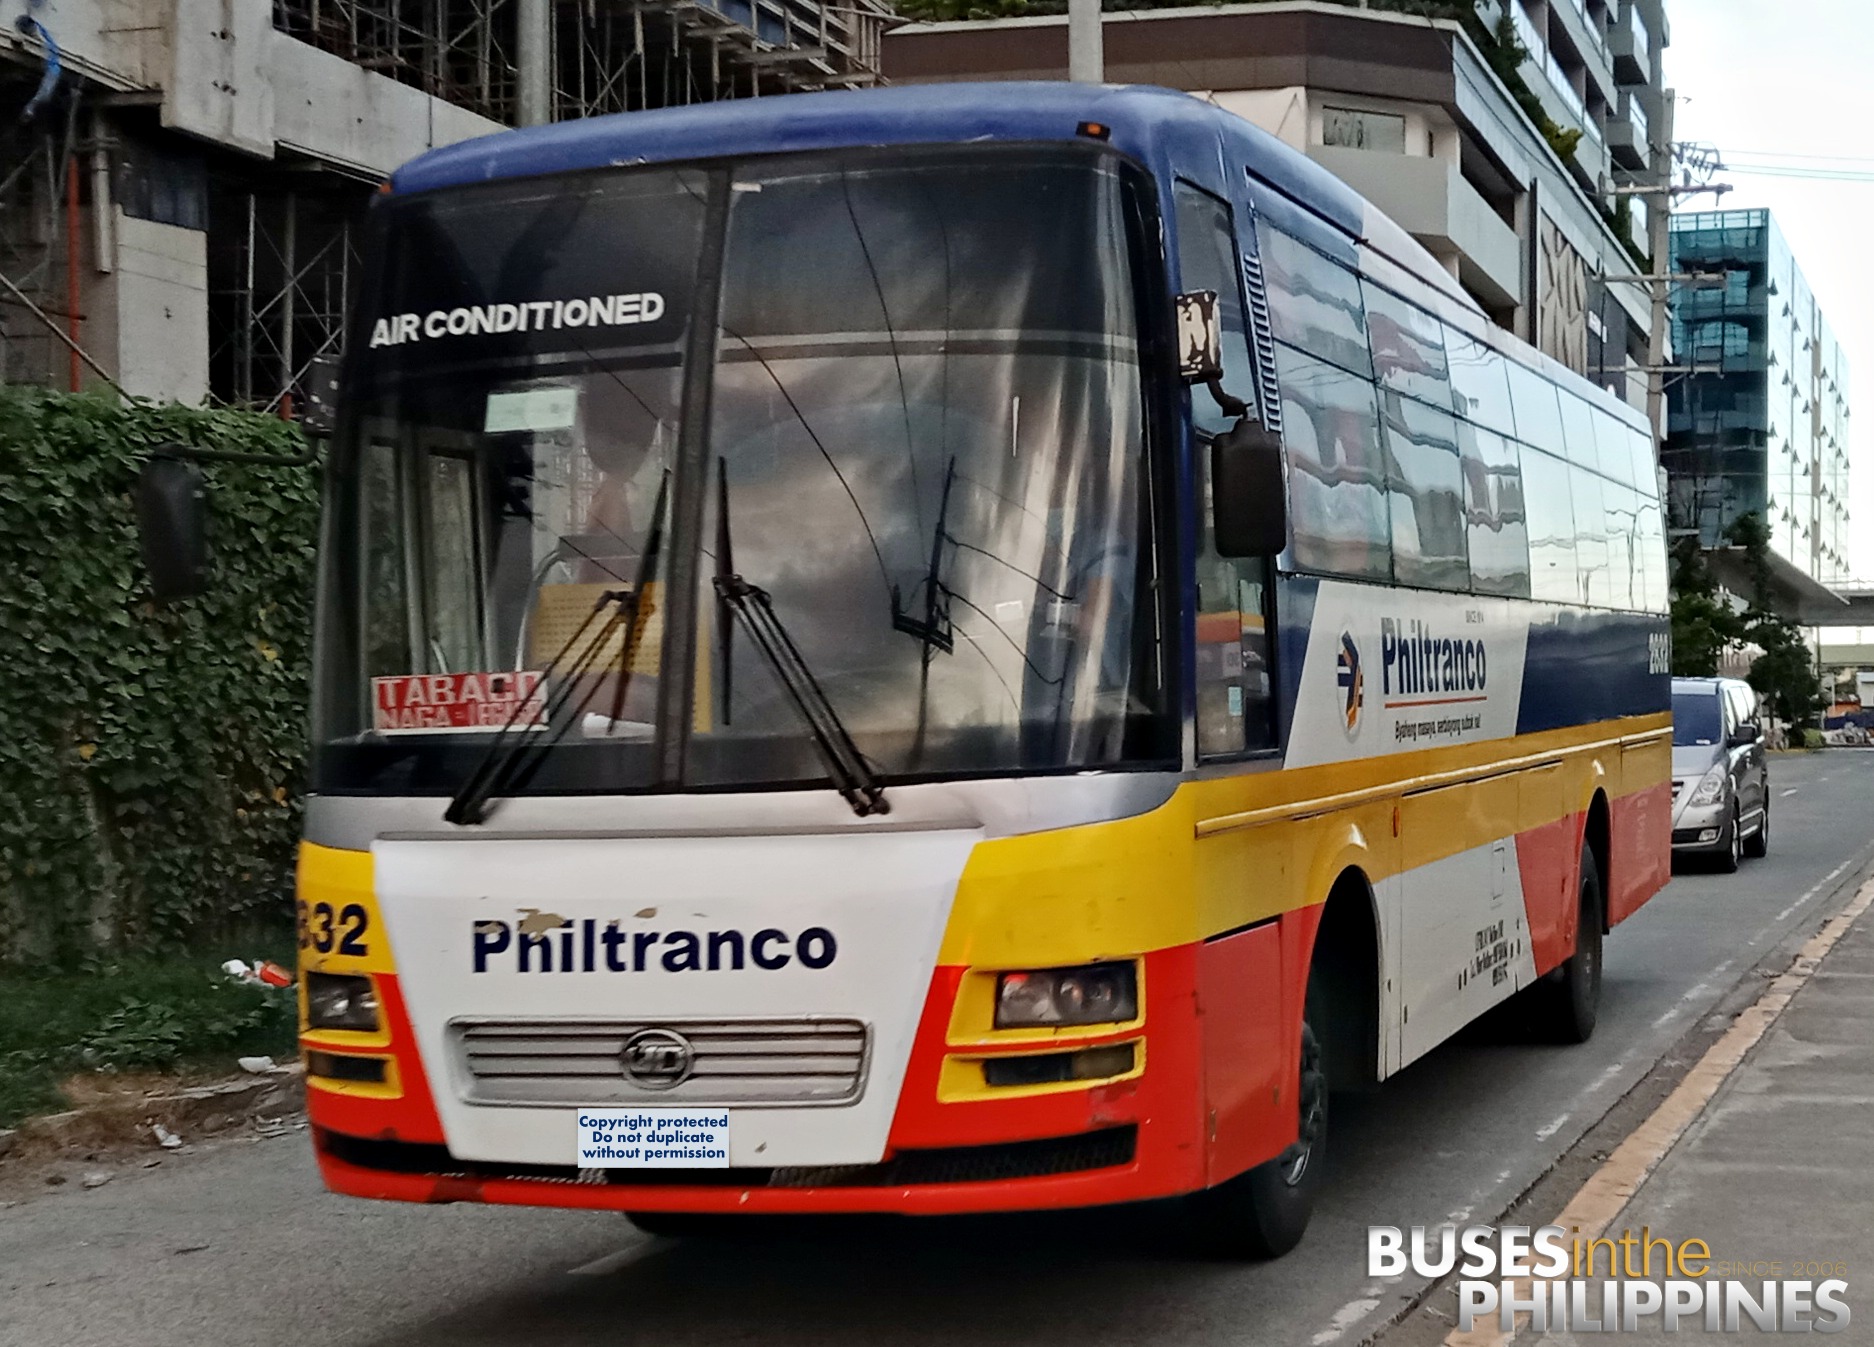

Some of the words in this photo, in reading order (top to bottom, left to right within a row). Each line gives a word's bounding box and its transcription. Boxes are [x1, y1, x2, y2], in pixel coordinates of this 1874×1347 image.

[369, 313, 420, 348] AIR
[424, 292, 665, 339] CONDITIONED
[1381, 617, 1487, 695] Philtranco
[472, 919, 838, 974] Philtranco
